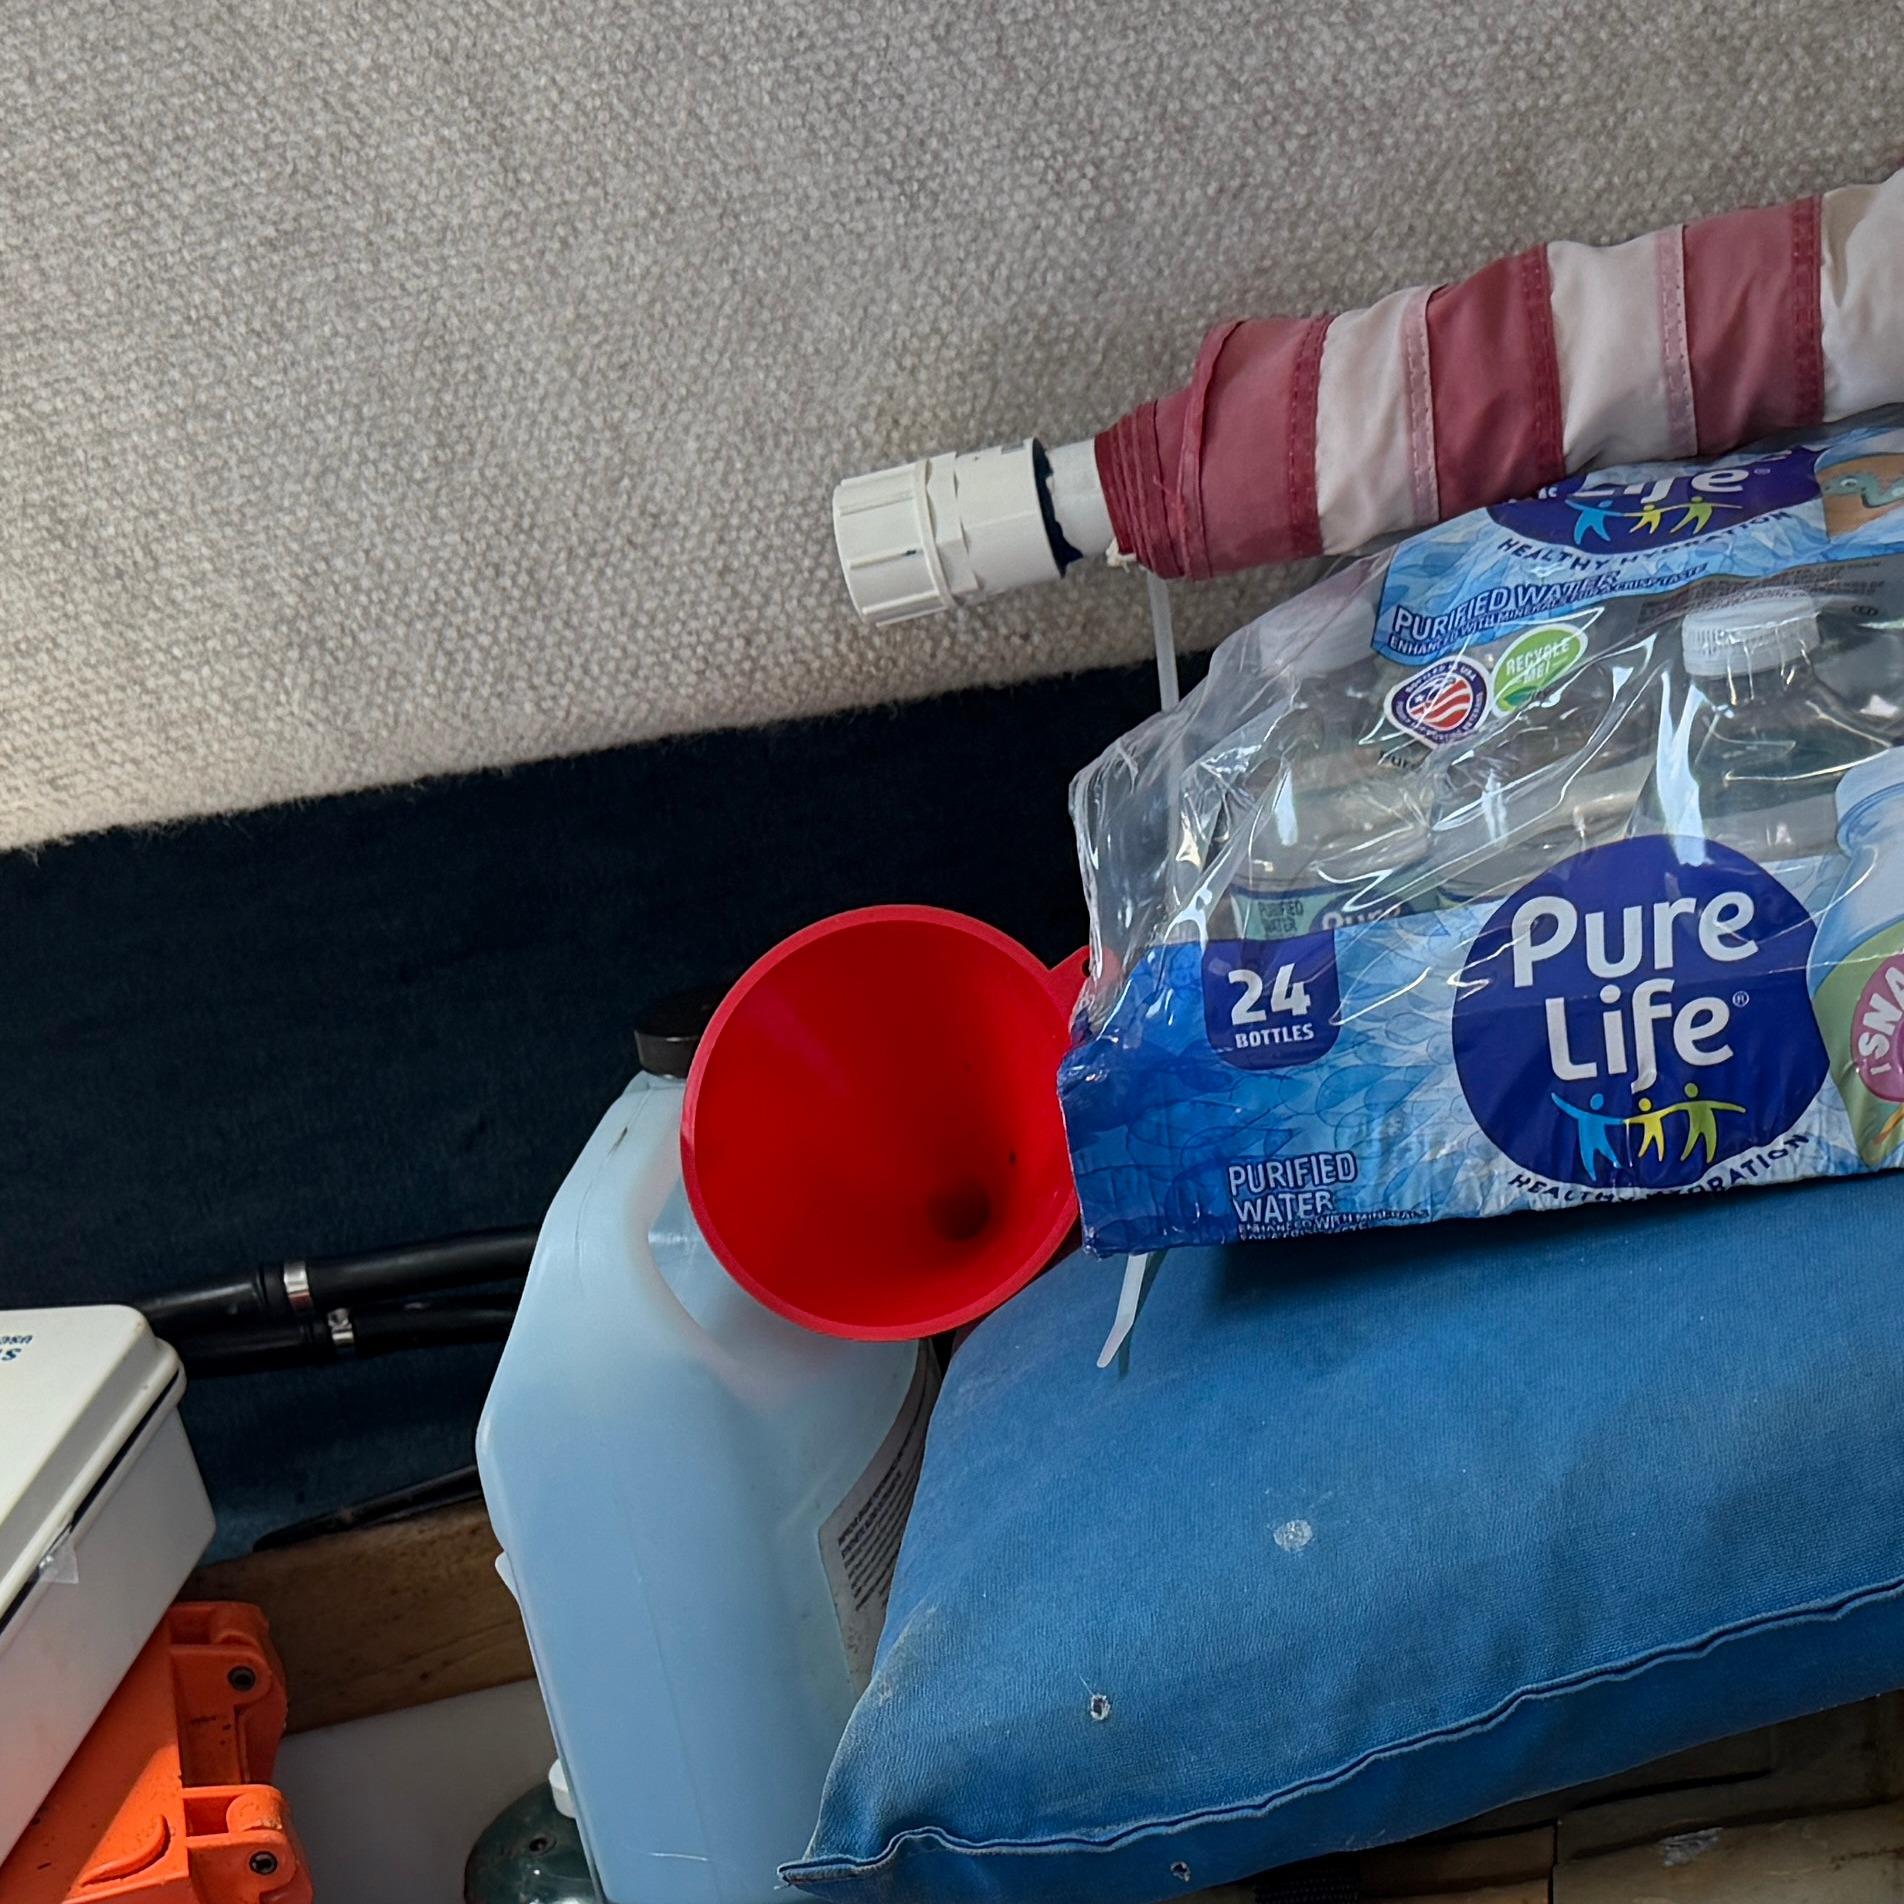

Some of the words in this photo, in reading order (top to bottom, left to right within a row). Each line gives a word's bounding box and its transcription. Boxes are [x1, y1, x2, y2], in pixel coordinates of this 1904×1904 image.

[1497, 536, 1616, 573] HEALTHY
[1393, 585, 1512, 642] PURIFIED
[1511, 890, 1760, 989] Pure
[1227, 963, 1312, 1026] 24
[1234, 1023, 1316, 1050] BOTTLES
[1544, 977, 1735, 1096] Life
[1228, 1151, 1358, 1198] PURIFIED
[1233, 1189, 1335, 1225] WATER
